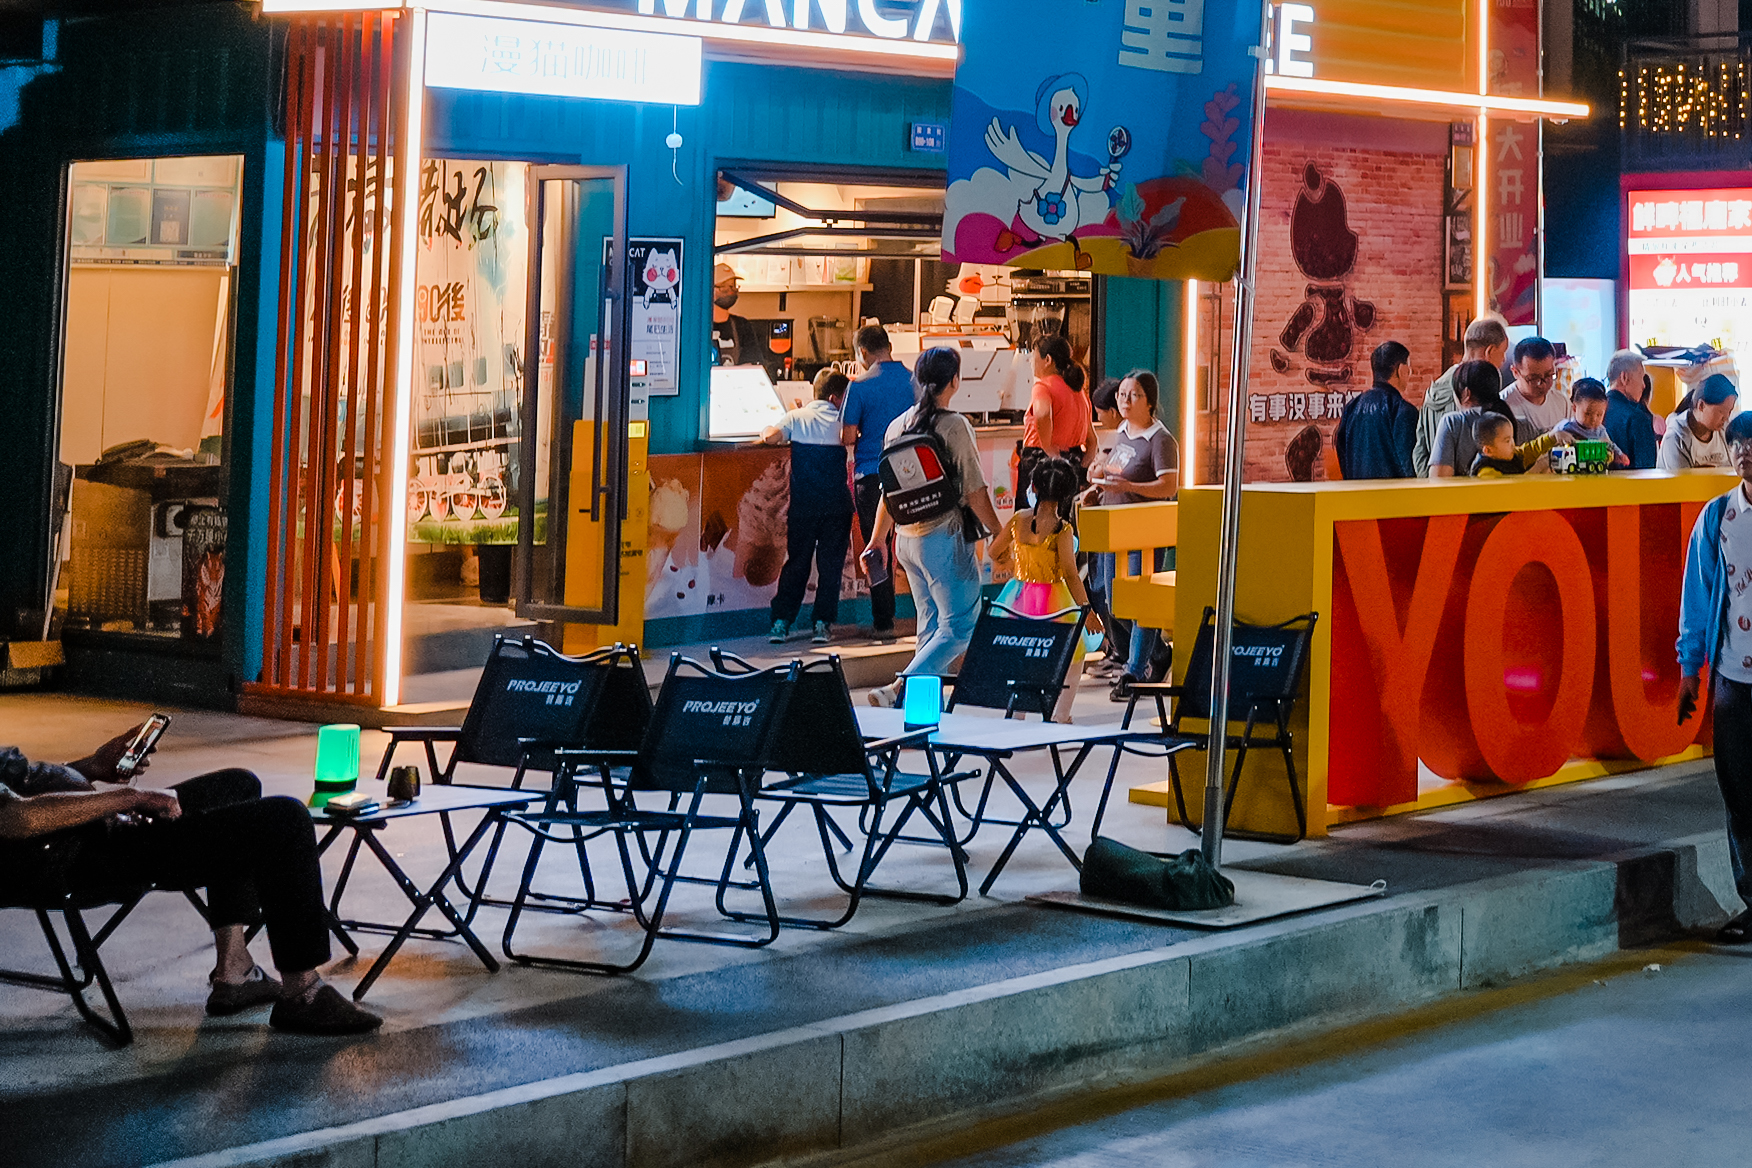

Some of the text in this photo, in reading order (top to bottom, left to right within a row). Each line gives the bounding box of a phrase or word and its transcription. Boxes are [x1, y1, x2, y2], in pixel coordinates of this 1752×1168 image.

[1265, 2, 1314, 78] E
[1496, 80, 1524, 249] 大开业
[1231, 645, 1283, 657] OJEEYO
[506, 679, 581, 694] PROJEEYO
[682, 699, 757, 714] PROJEEYO
